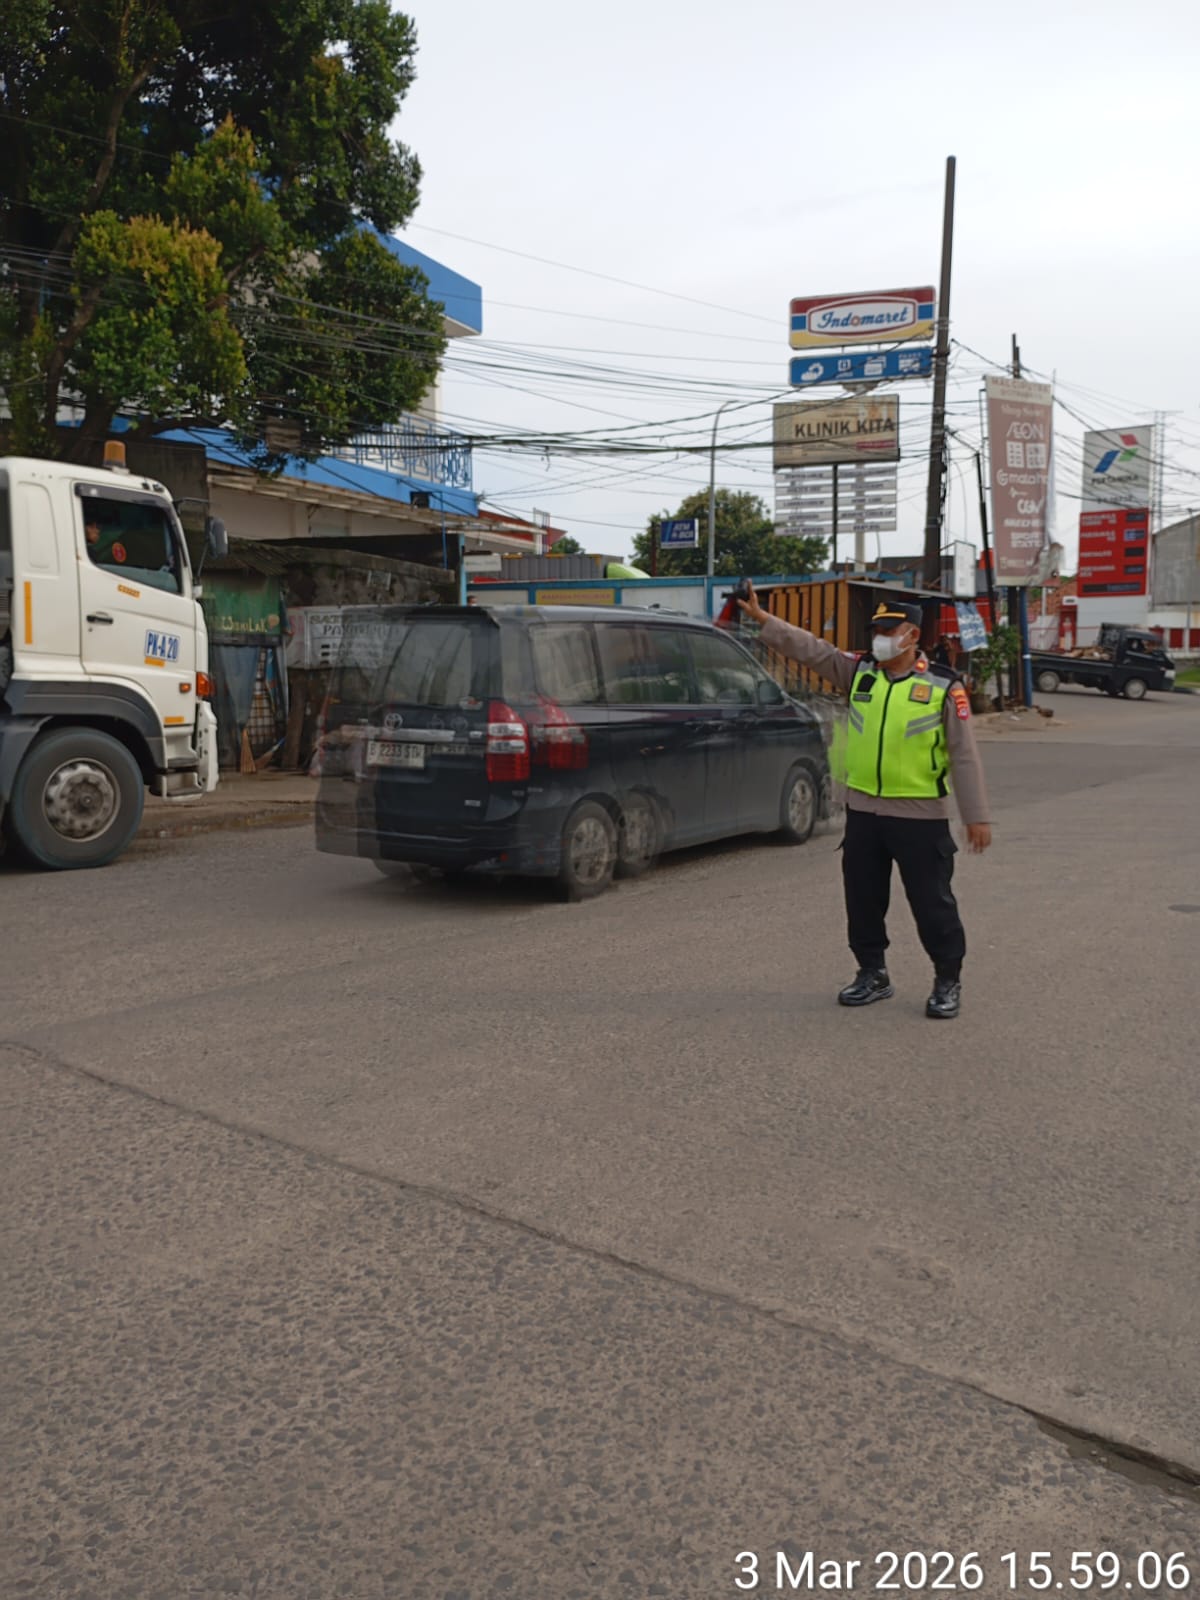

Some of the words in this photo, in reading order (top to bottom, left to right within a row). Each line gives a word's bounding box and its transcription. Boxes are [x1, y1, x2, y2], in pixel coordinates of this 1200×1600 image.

[816, 306, 910, 329] Indomaret
[794, 420, 851, 438] KLINIK
[856, 417, 896, 434] KITA
